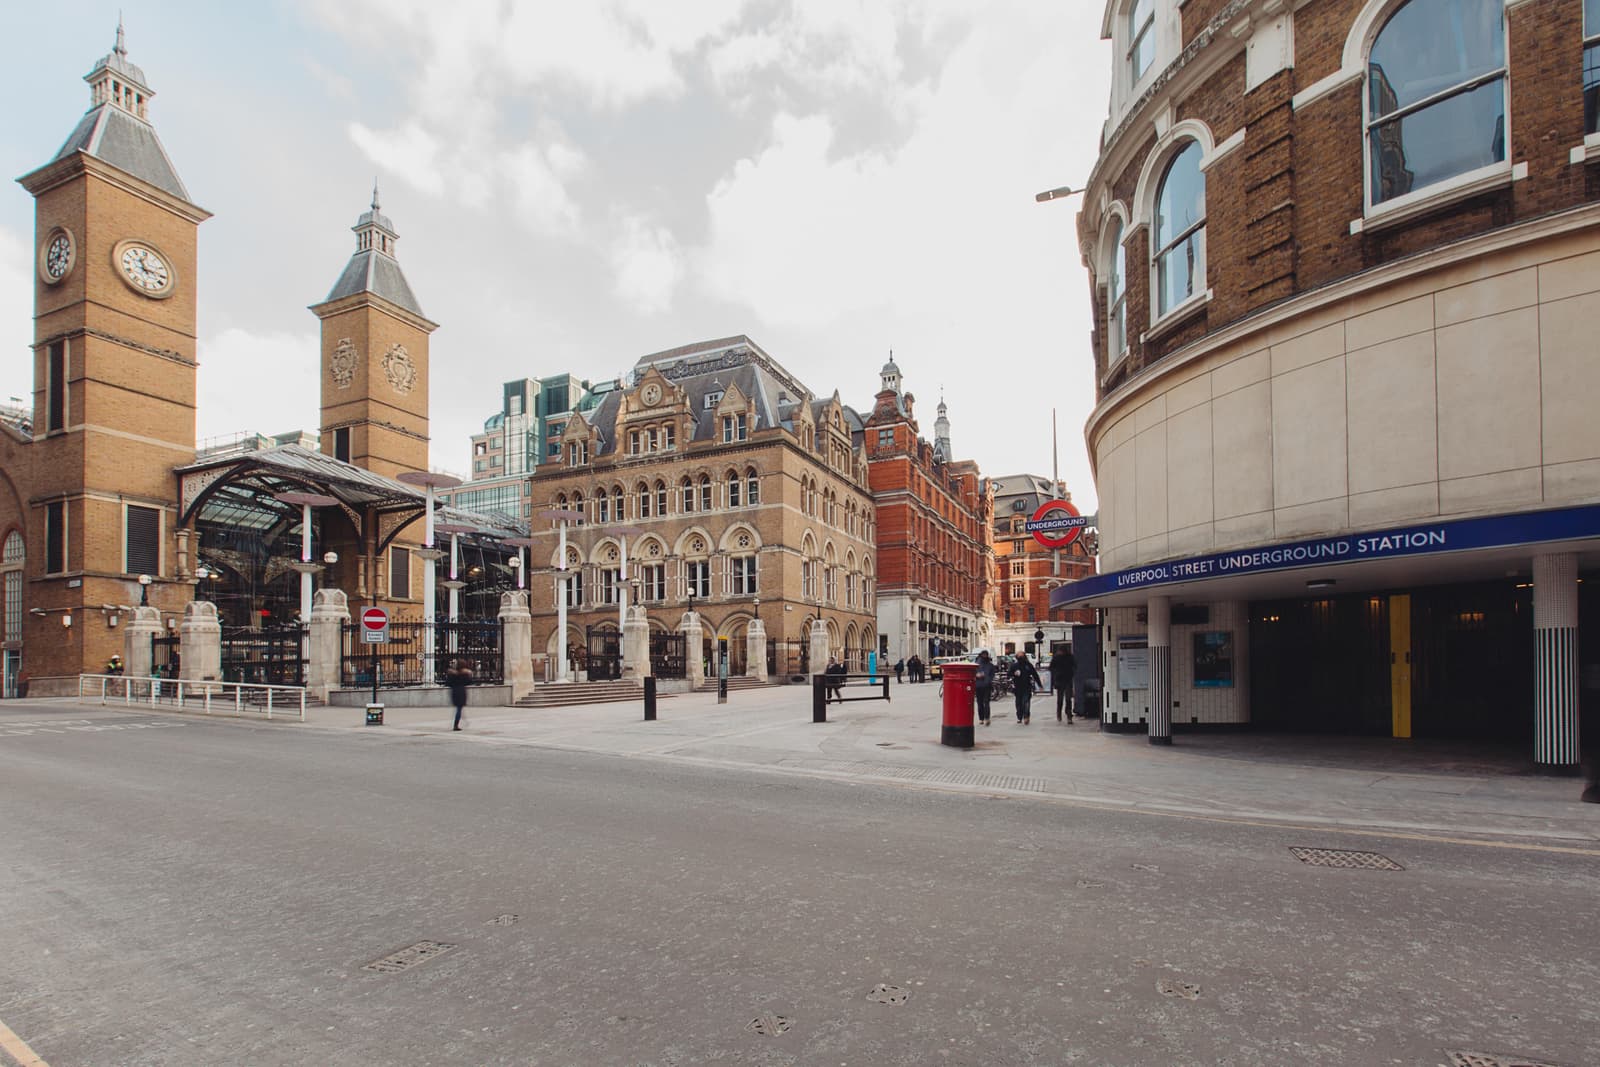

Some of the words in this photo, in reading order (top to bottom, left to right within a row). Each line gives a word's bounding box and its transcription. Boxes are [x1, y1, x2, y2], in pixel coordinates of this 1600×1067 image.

[1027, 518, 1085, 530] UNDERGROUND
[1118, 567, 1169, 586] LIVERPOOL
[1172, 560, 1215, 577] STREET
[1219, 541, 1350, 570] UNDERGROUND
[1358, 530, 1446, 553] STATION
